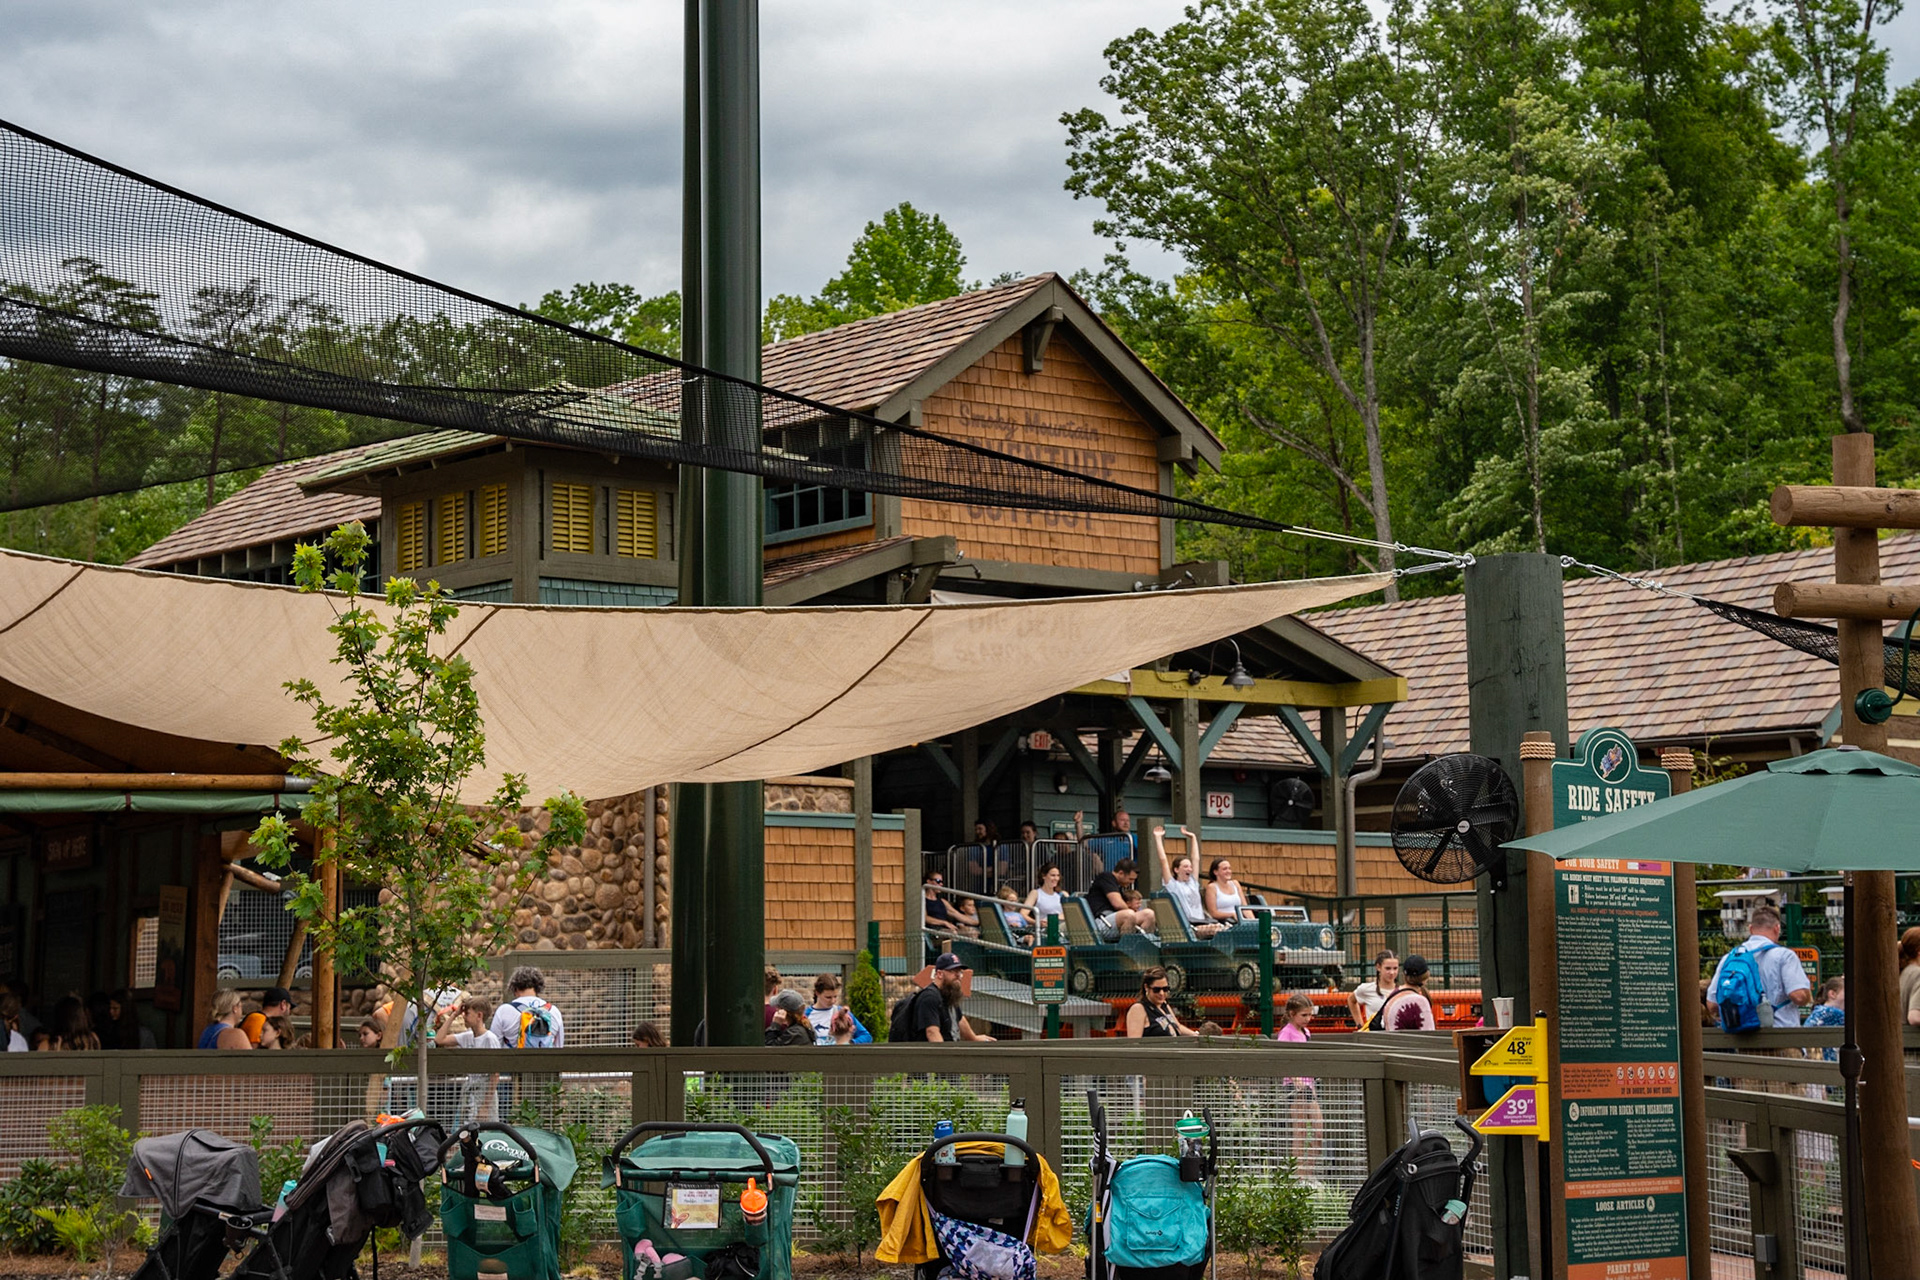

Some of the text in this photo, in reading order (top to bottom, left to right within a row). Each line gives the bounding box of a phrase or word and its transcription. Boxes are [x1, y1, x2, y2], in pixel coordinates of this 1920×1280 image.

[958, 403, 1101, 442] Smoky Mountain
[1034, 733, 1048, 748] EXIT
[1210, 795, 1230, 808] FDC
[1567, 784, 1656, 813] RIDE SAFETY
[1565, 858, 1577, 867] FOR
[1579, 858, 1595, 868] YOUR
[1597, 859, 1619, 870] SAFETY
[1596, 1201, 1614, 1212] LOOSE
[1616, 1199, 1645, 1211] ARTICLES
[1607, 1262, 1650, 1275] PARENT SWAP
